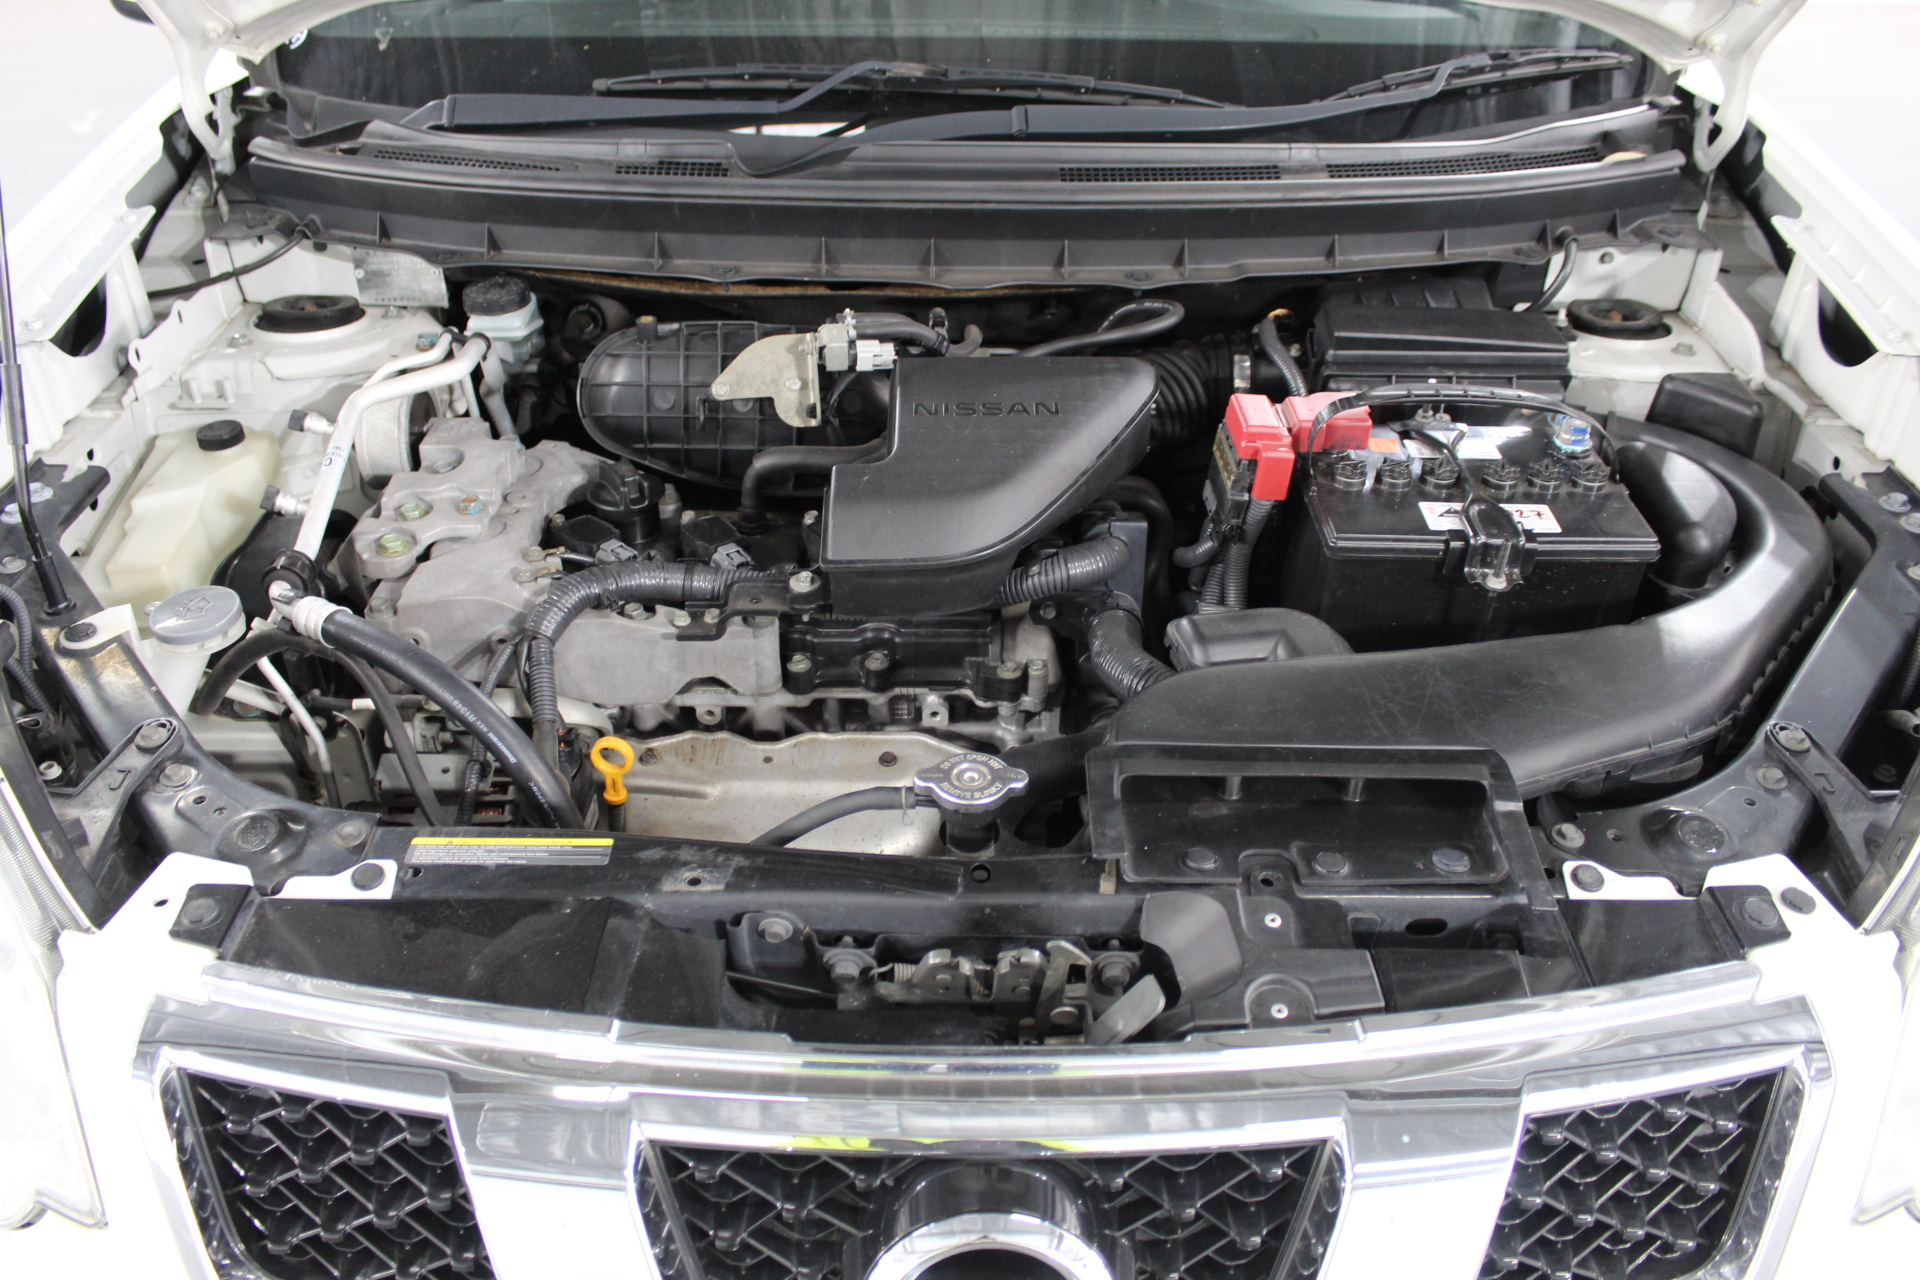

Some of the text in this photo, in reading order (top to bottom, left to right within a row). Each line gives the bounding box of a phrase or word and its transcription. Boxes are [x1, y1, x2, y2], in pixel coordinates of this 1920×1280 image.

[913, 401, 1060, 417] NISSAN
[940, 754, 1004, 770] DO NOT OPEN HOT
[939, 781, 1003, 799] REMOVE SLOWLY
